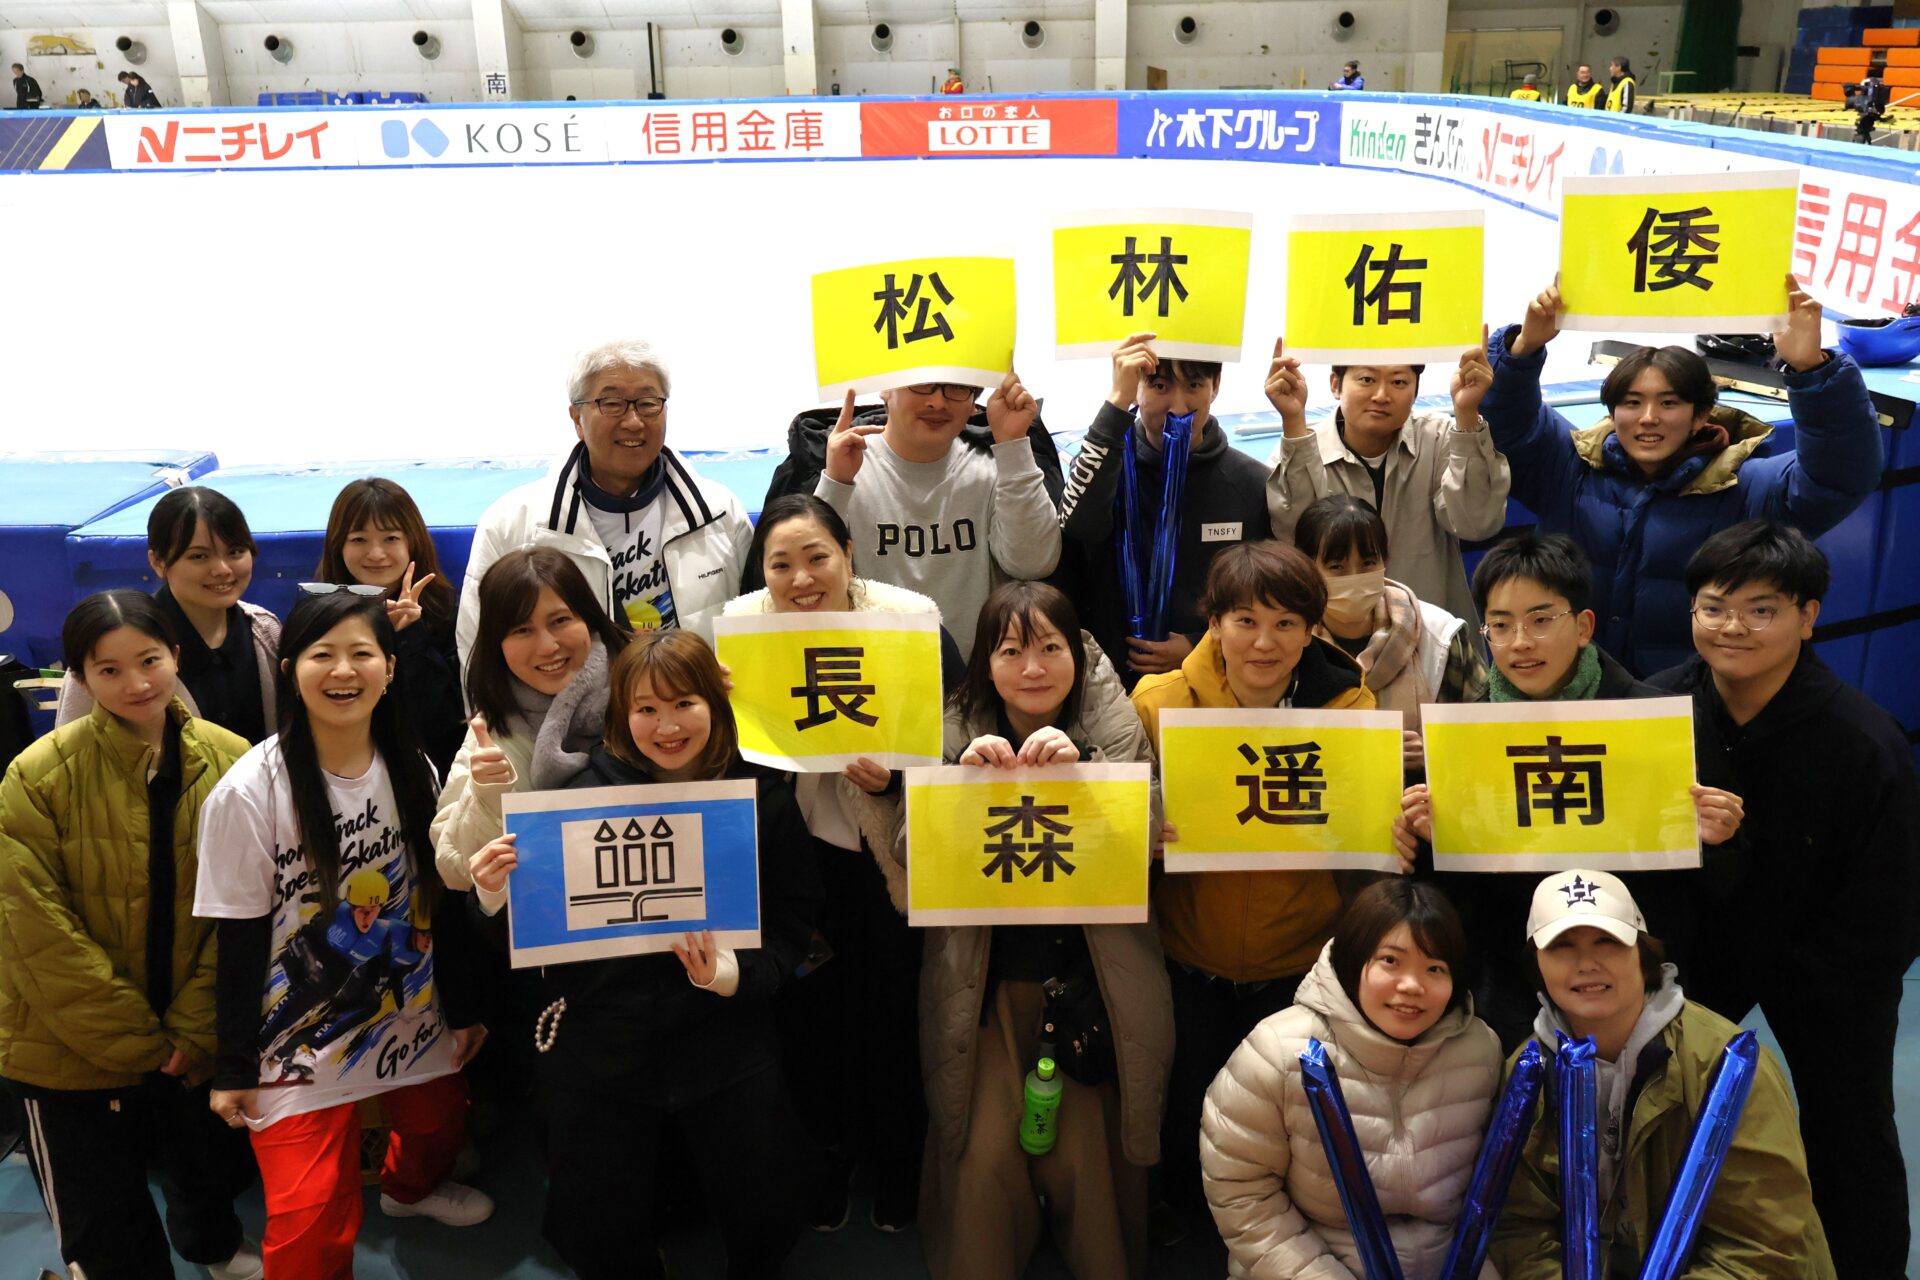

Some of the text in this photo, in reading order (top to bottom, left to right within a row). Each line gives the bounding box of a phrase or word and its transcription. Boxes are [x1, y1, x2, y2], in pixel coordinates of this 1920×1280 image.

[486, 73, 506, 94] 南
[466, 114, 581, 153] KOSÉ
[642, 110, 824, 154] 信用金庫
[939, 105, 1040, 119] お口の恋人
[1176, 108, 1320, 151] 木下グループ
[183, 121, 328, 161] ニチレイ
[941, 126, 1038, 145] LOTTE
[1350, 119, 1406, 162] Kinden
[1627, 206, 1720, 292] 倭
[1108, 236, 1189, 317] 林
[1344, 244, 1427, 325] 佑
[873, 272, 955, 349] 松
[876, 519, 976, 557] POLO
[1207, 527, 1237, 537] TNSFY
[698, 567, 724, 580] HILFIGER
[790, 647, 879, 733] 長
[1236, 741, 1329, 826] 遥
[1506, 736, 1607, 827] 南
[982, 796, 1076, 883] 森
[272, 826, 404, 914] Spee Skatin
[368, 895, 380, 905] 10
[376, 1021, 437, 1080] Go for
